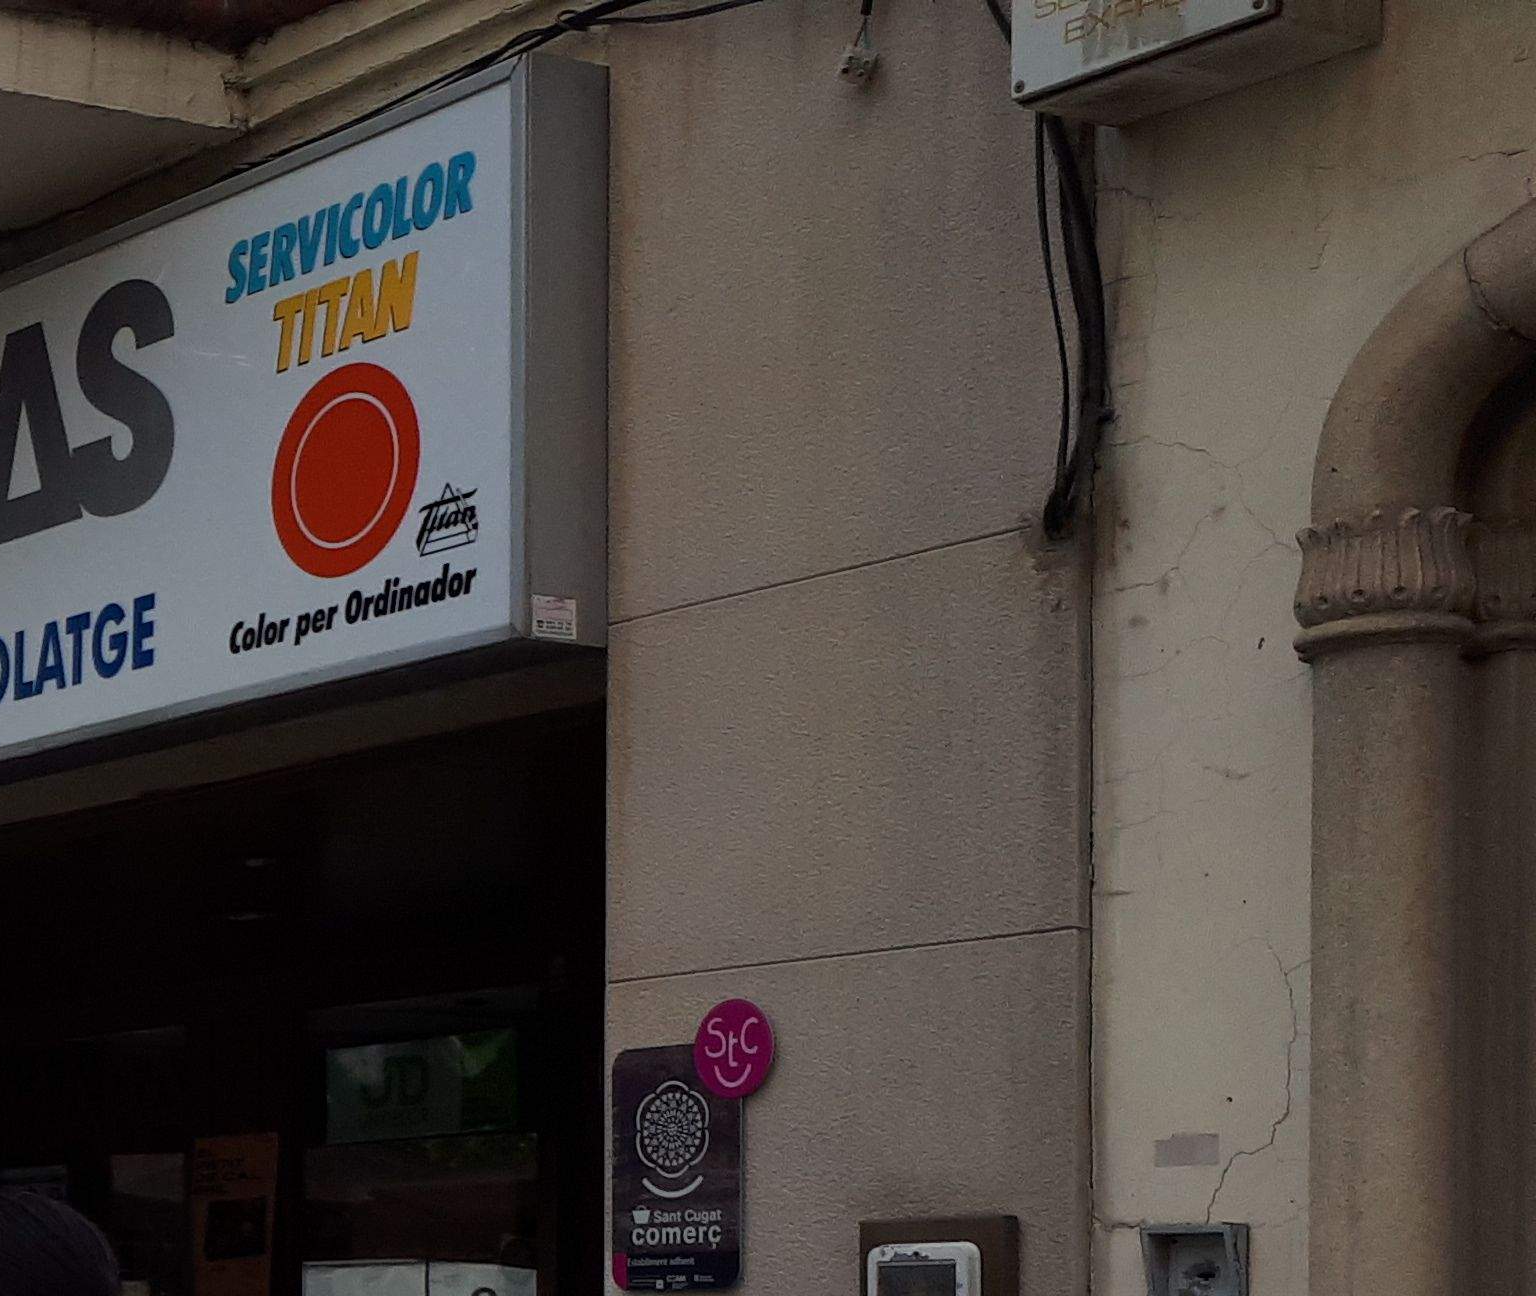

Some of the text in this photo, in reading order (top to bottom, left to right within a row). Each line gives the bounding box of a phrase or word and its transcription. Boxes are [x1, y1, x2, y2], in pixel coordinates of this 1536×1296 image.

[225, 150, 478, 304] SERVICOLOR
[272, 250, 421, 374] TITAN
[229, 562, 478, 655] Color per Ordinador
[631, 1225, 722, 1250] comerç
[653, 1208, 723, 1224] Sant Cugat
